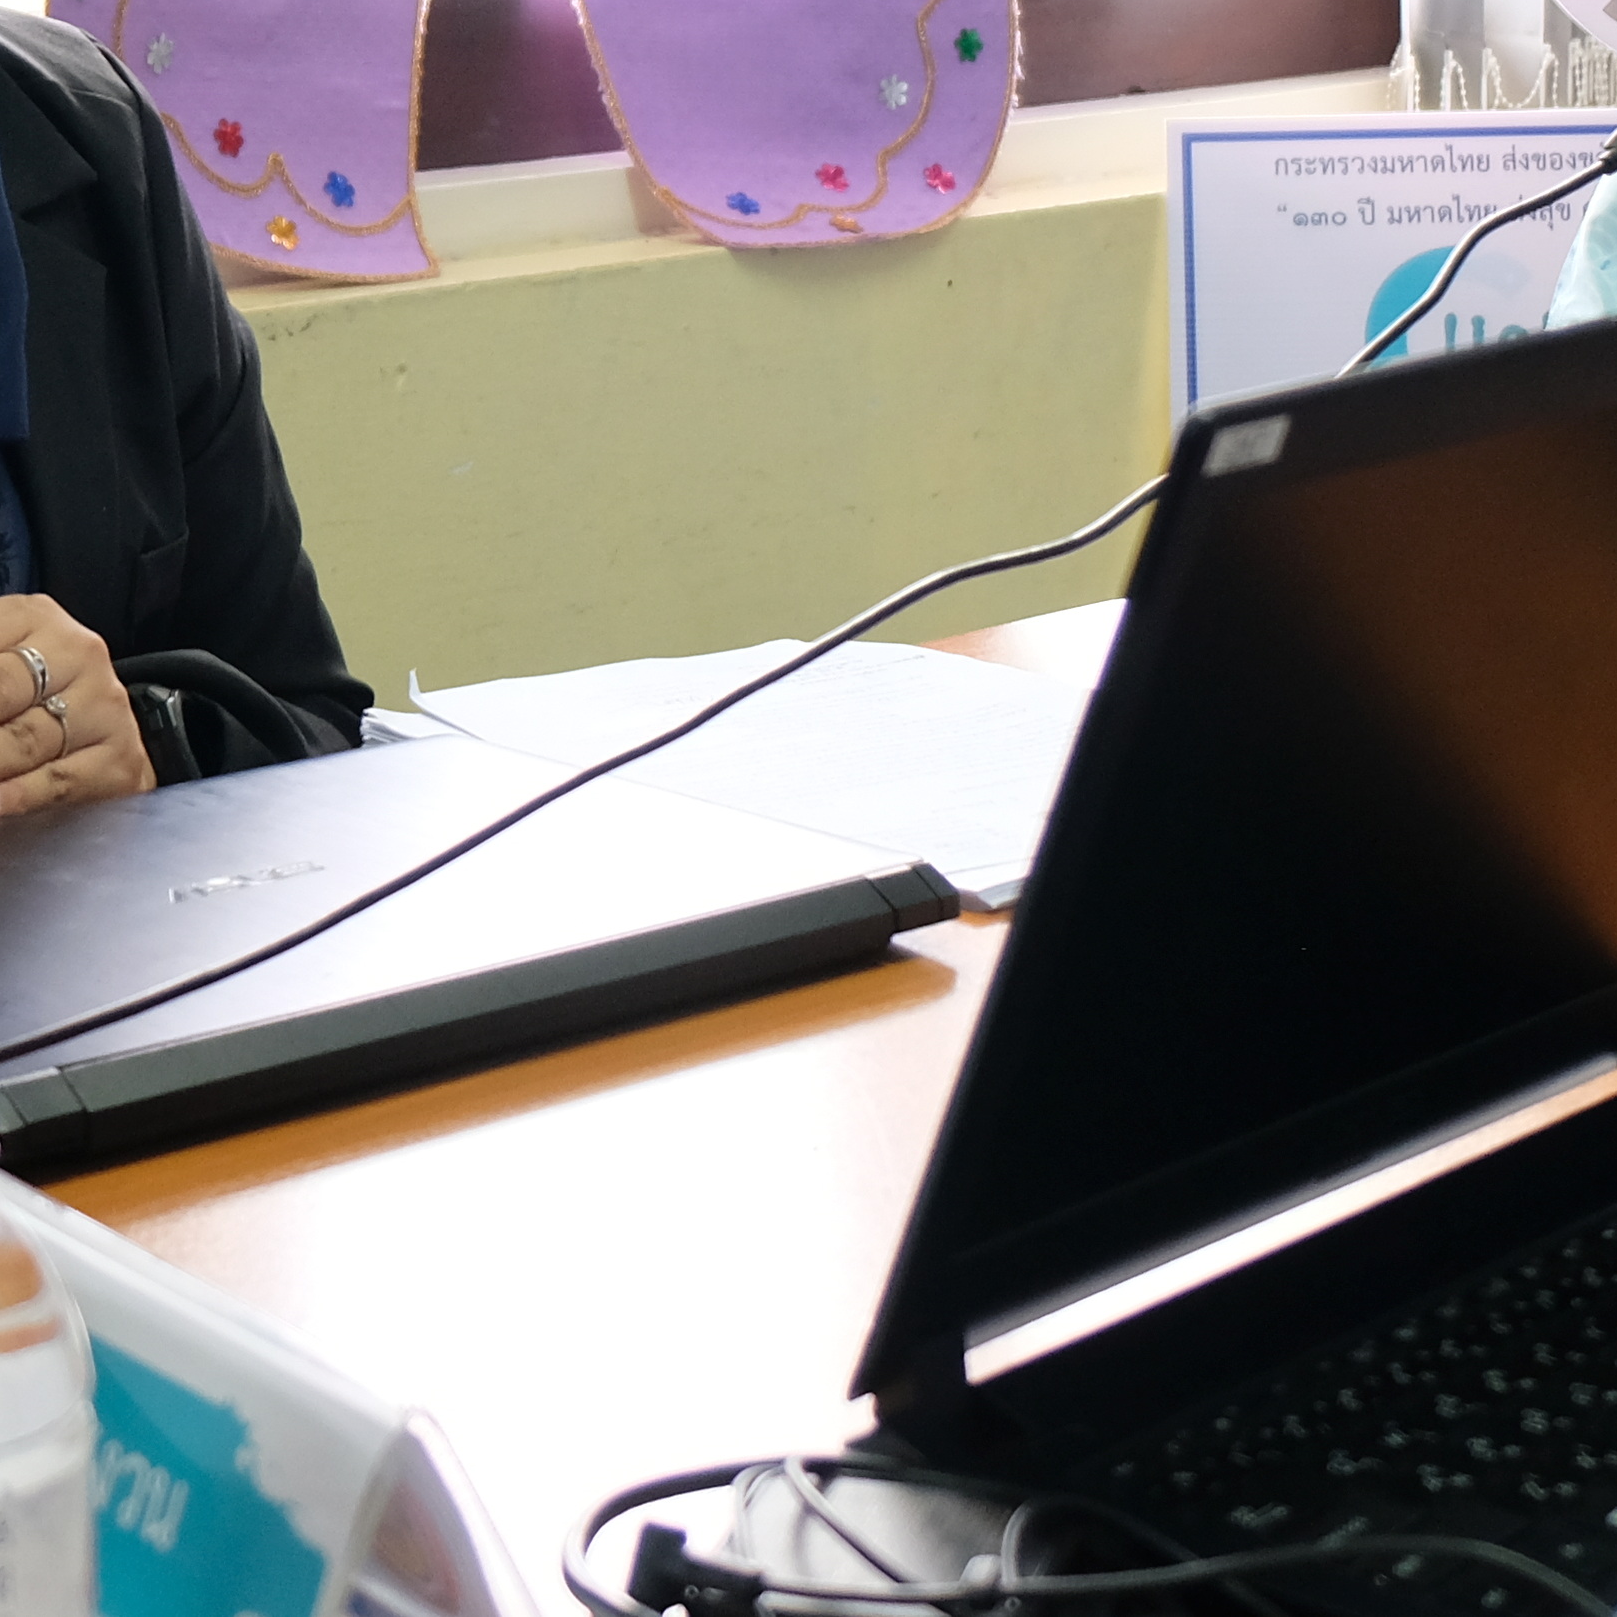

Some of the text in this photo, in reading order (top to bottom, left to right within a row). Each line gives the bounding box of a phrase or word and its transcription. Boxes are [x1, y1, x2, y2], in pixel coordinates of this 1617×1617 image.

[1274, 144, 1491, 176] กระทรวงมหาดไทย
[1357, 197, 1376, 226] ปี
